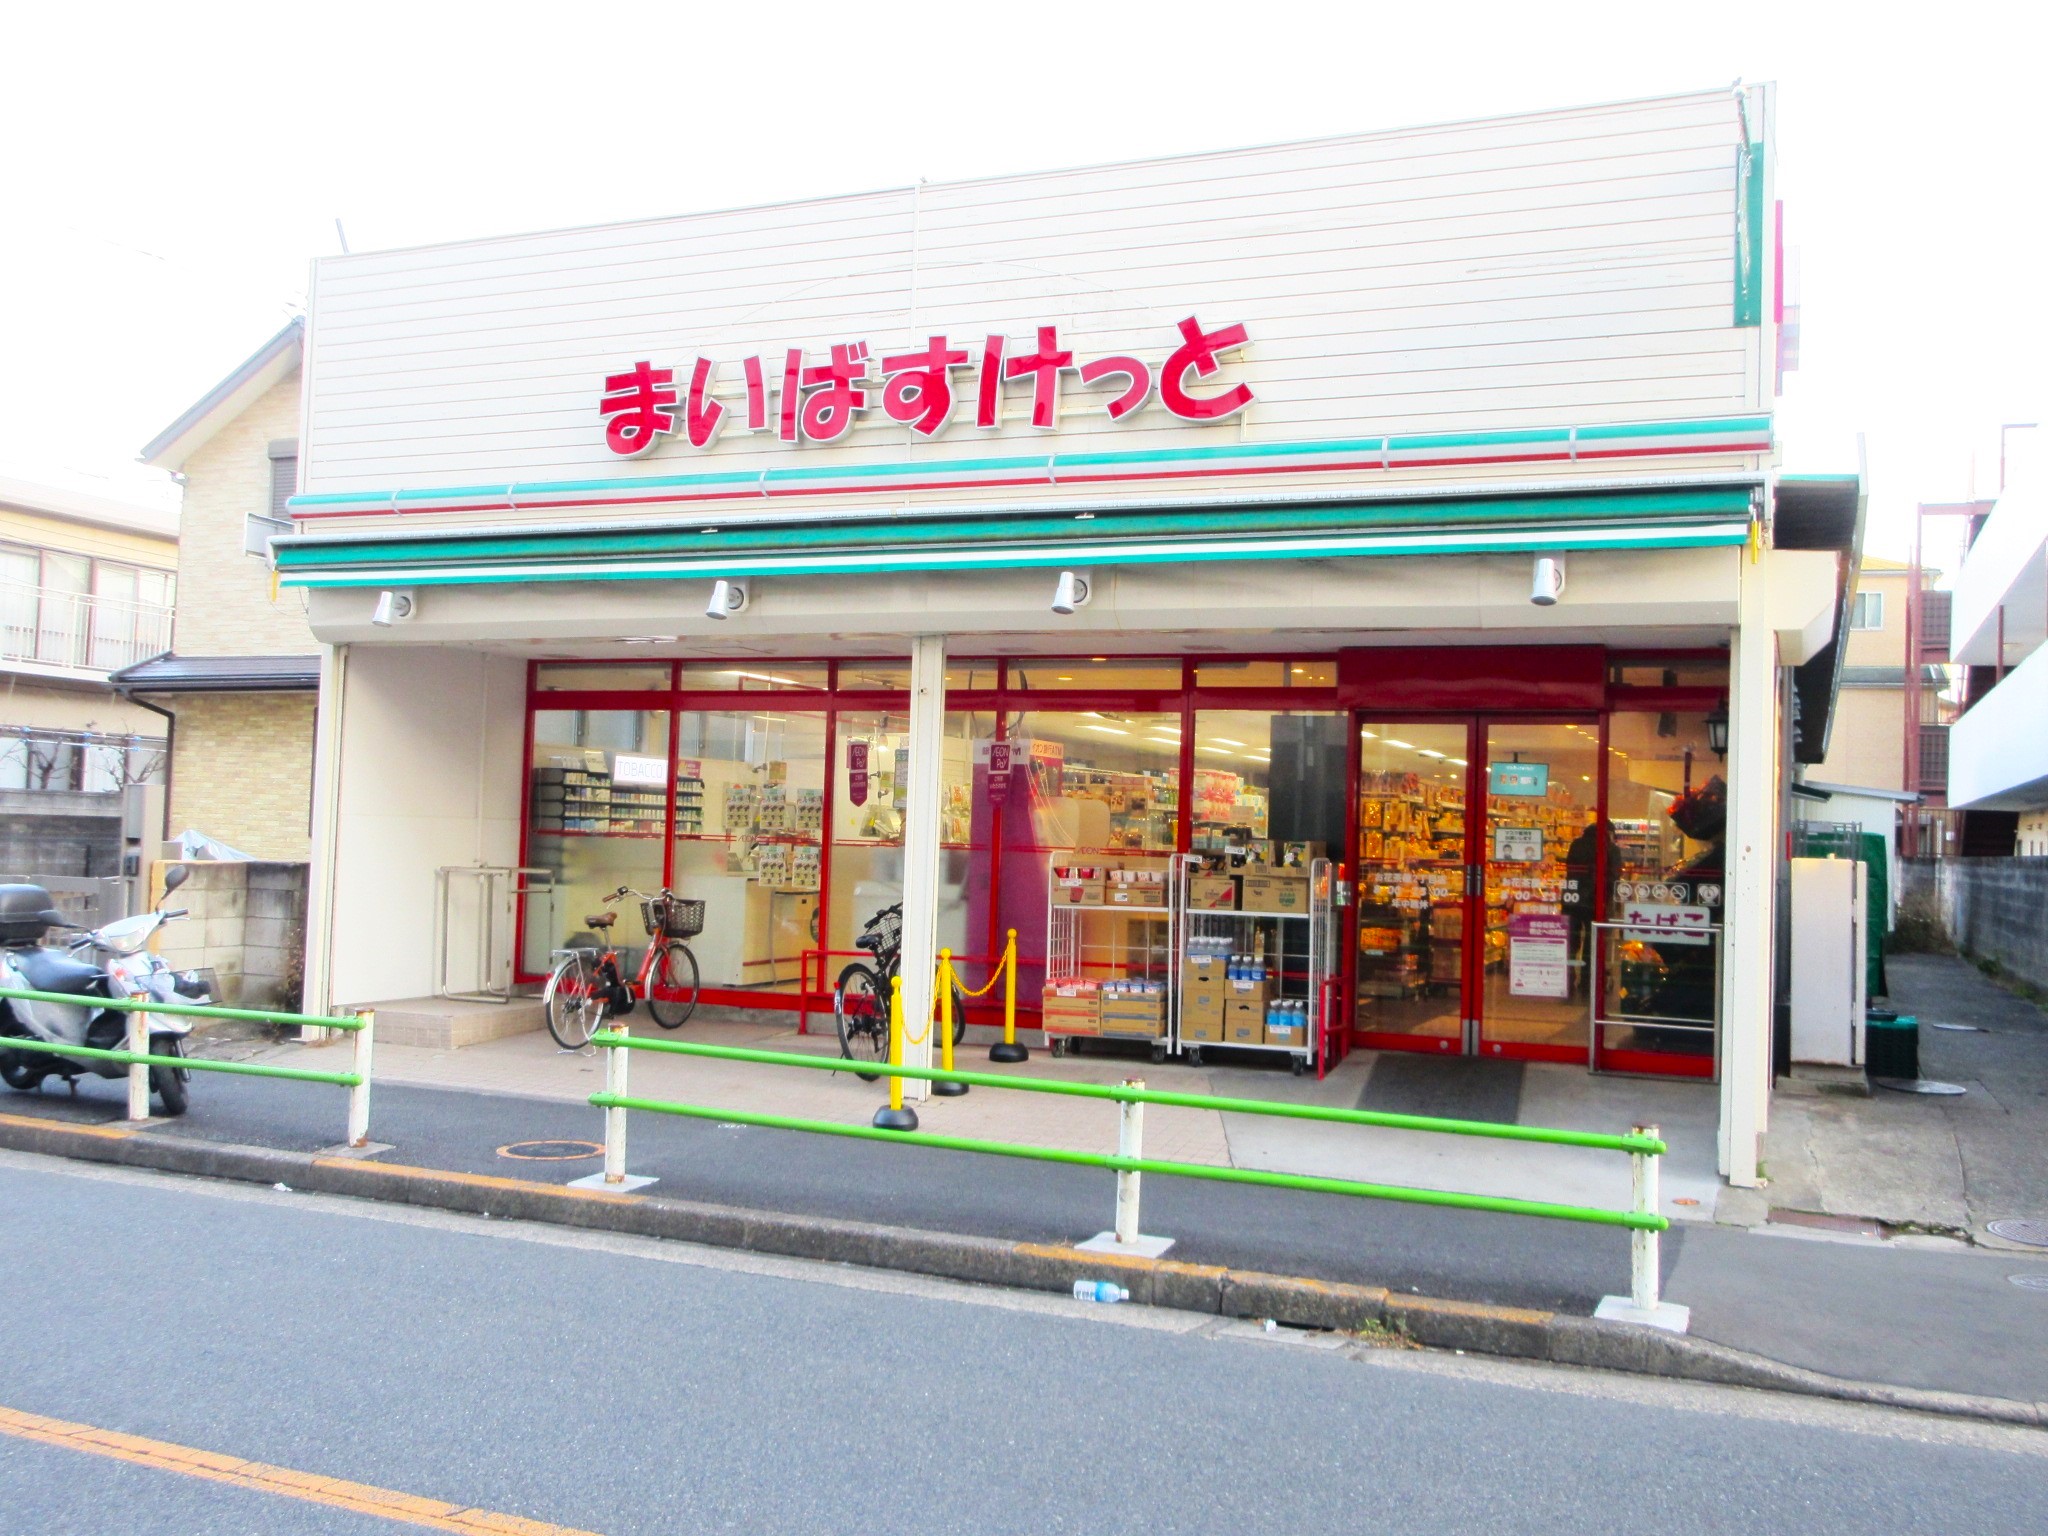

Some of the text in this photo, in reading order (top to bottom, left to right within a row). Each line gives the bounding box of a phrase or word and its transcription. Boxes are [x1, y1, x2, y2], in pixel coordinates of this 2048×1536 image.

[600, 314, 1258, 458] まいばすけっと
[617, 761, 664, 778] TOBACCO
[1627, 911, 1705, 938] たばこ
